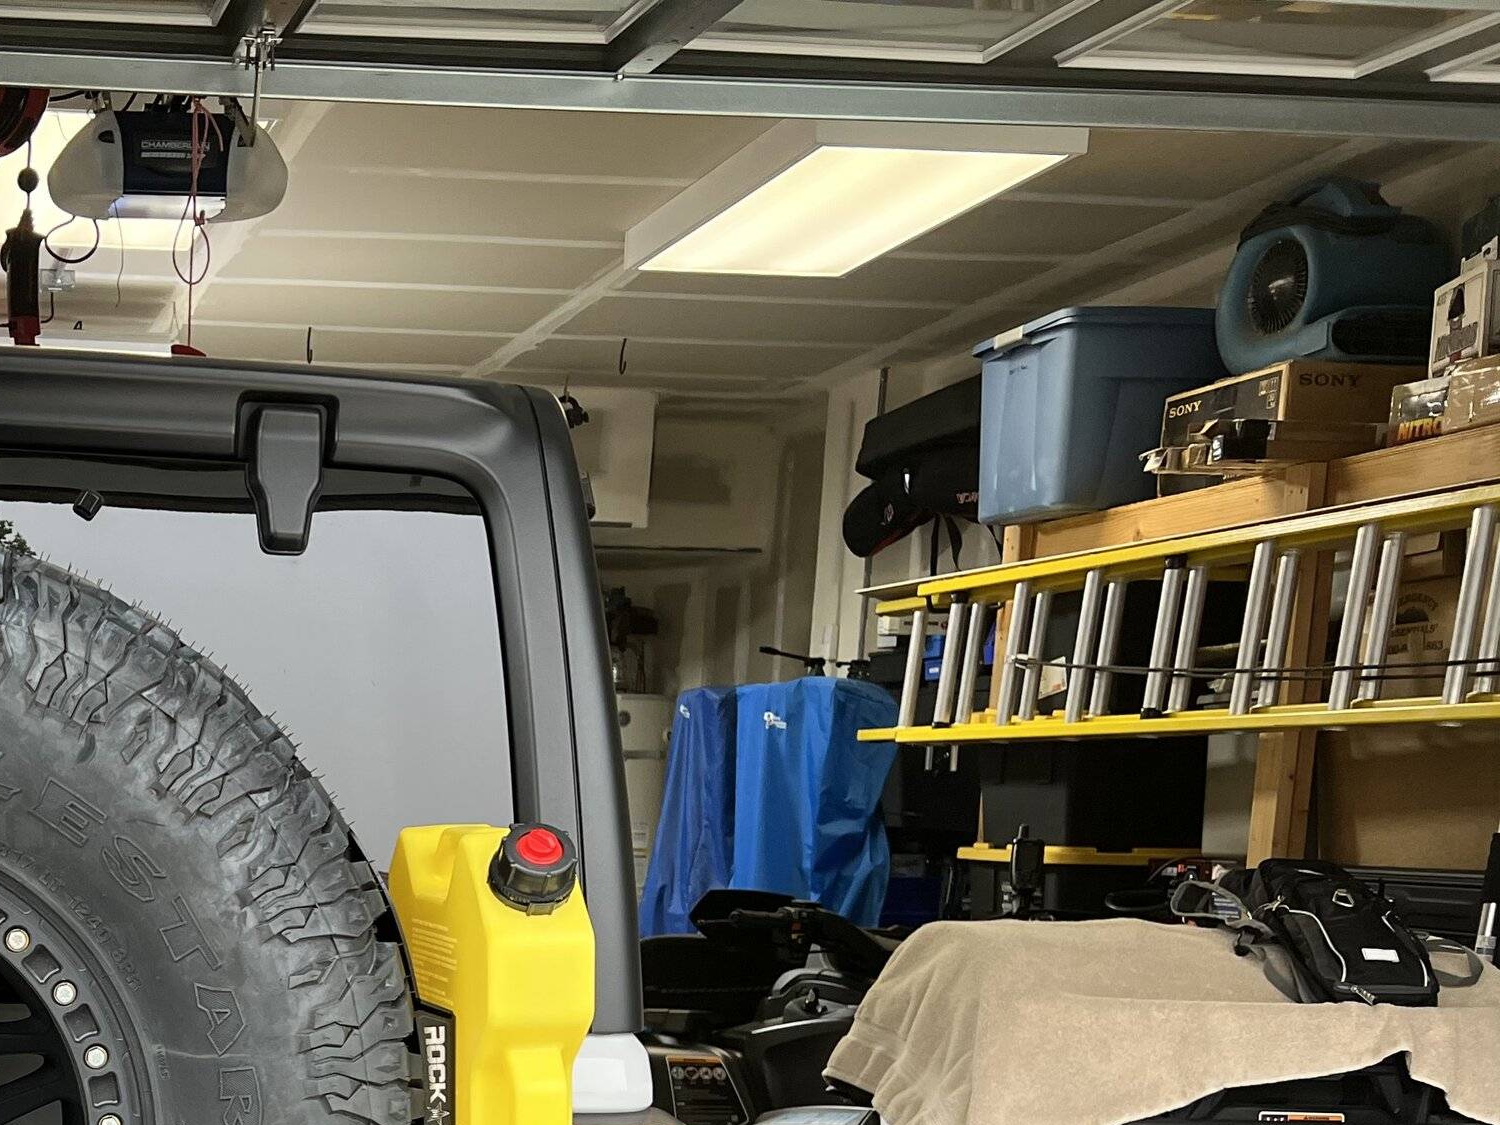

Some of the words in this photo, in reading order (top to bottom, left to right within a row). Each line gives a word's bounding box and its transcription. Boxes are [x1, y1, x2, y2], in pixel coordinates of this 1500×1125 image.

[1299, 373, 1362, 387] SONY
[1168, 400, 1202, 419] SONY
[423, 1025, 447, 1104] ROCK
